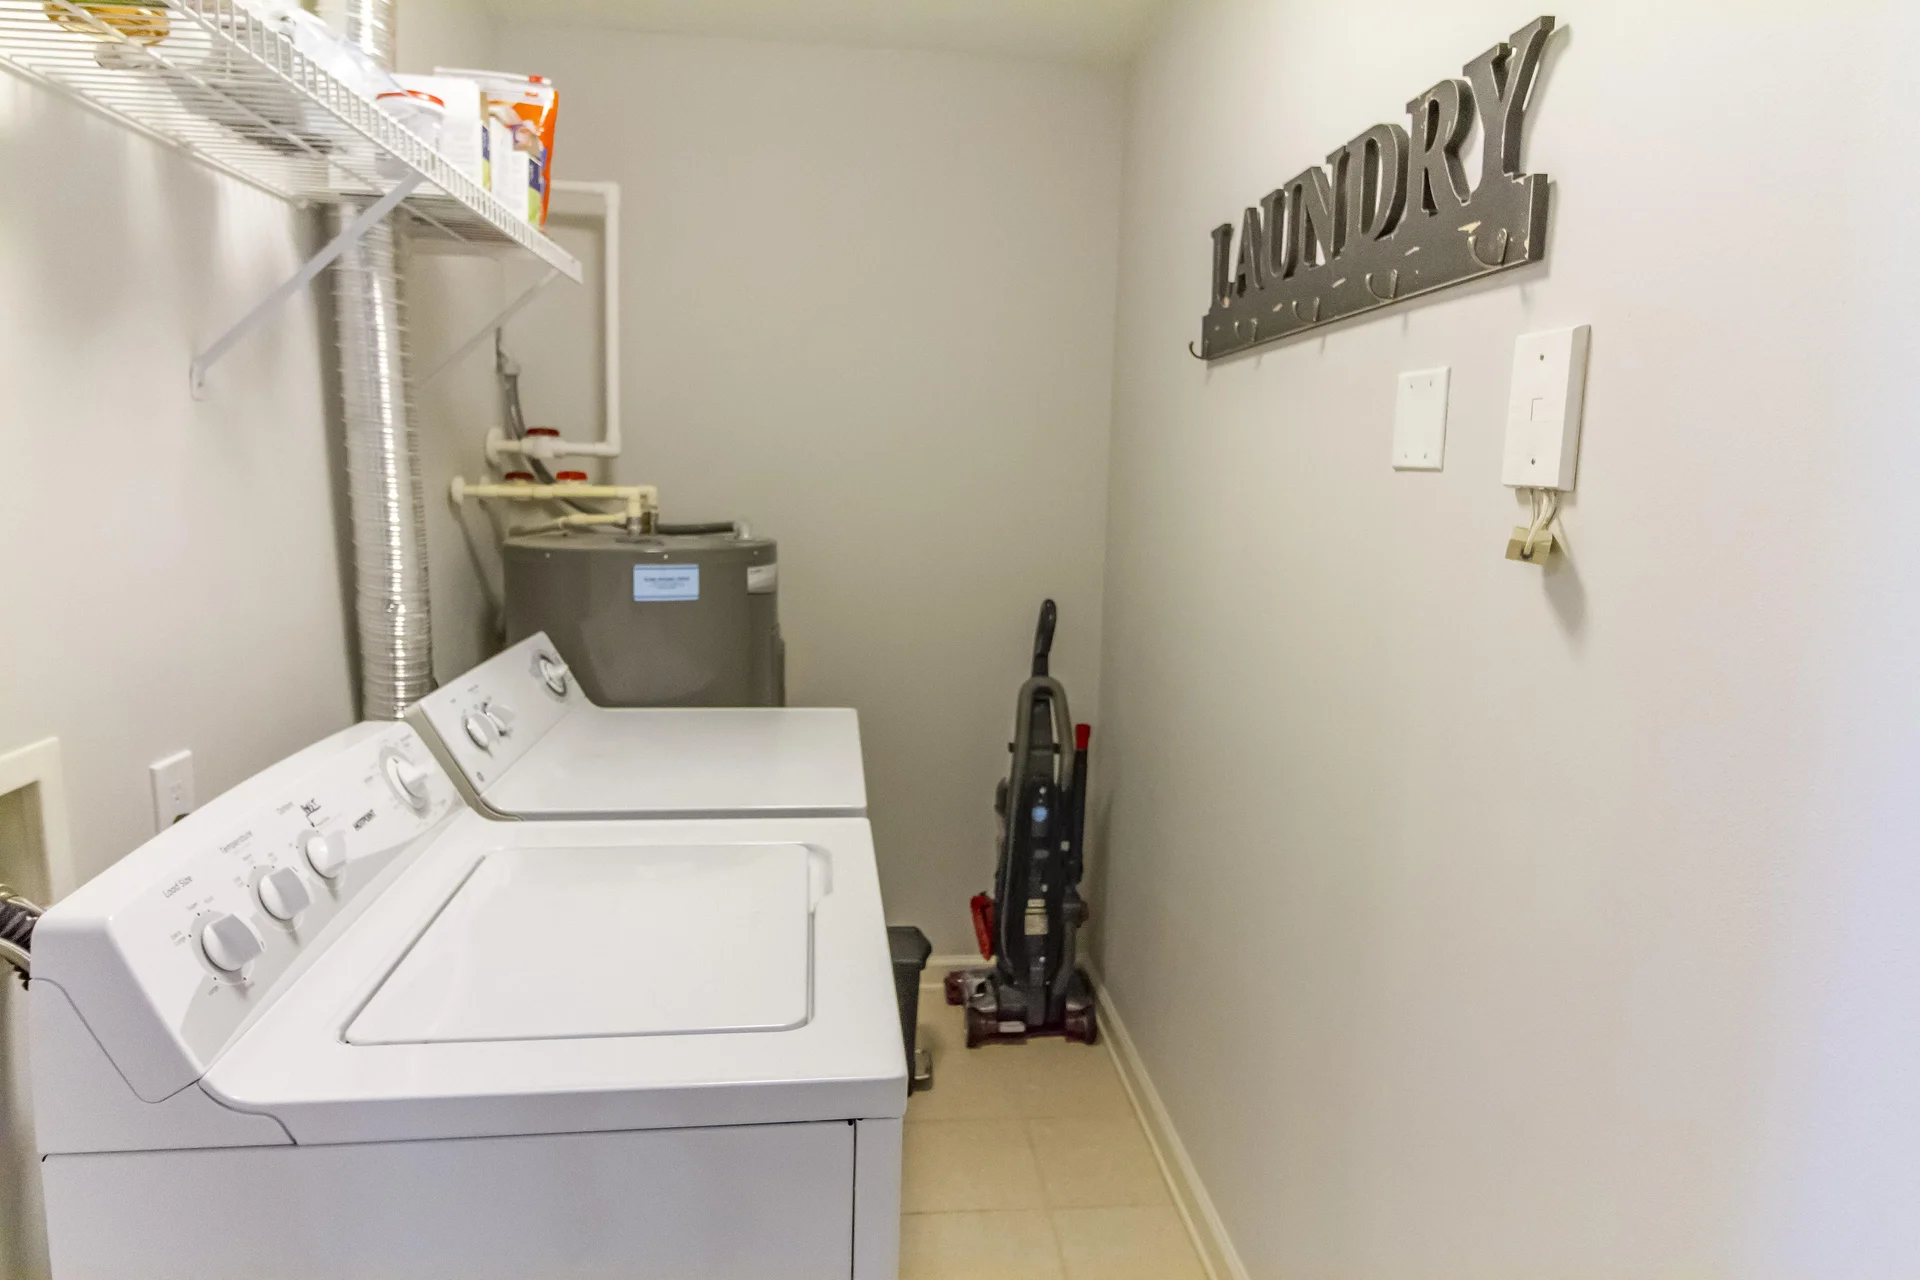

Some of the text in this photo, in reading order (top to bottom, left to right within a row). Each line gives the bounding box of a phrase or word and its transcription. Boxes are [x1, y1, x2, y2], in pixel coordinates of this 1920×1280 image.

[1210, 15, 1556, 308] LAUNDRY
[162, 875, 193, 898] Load Size
